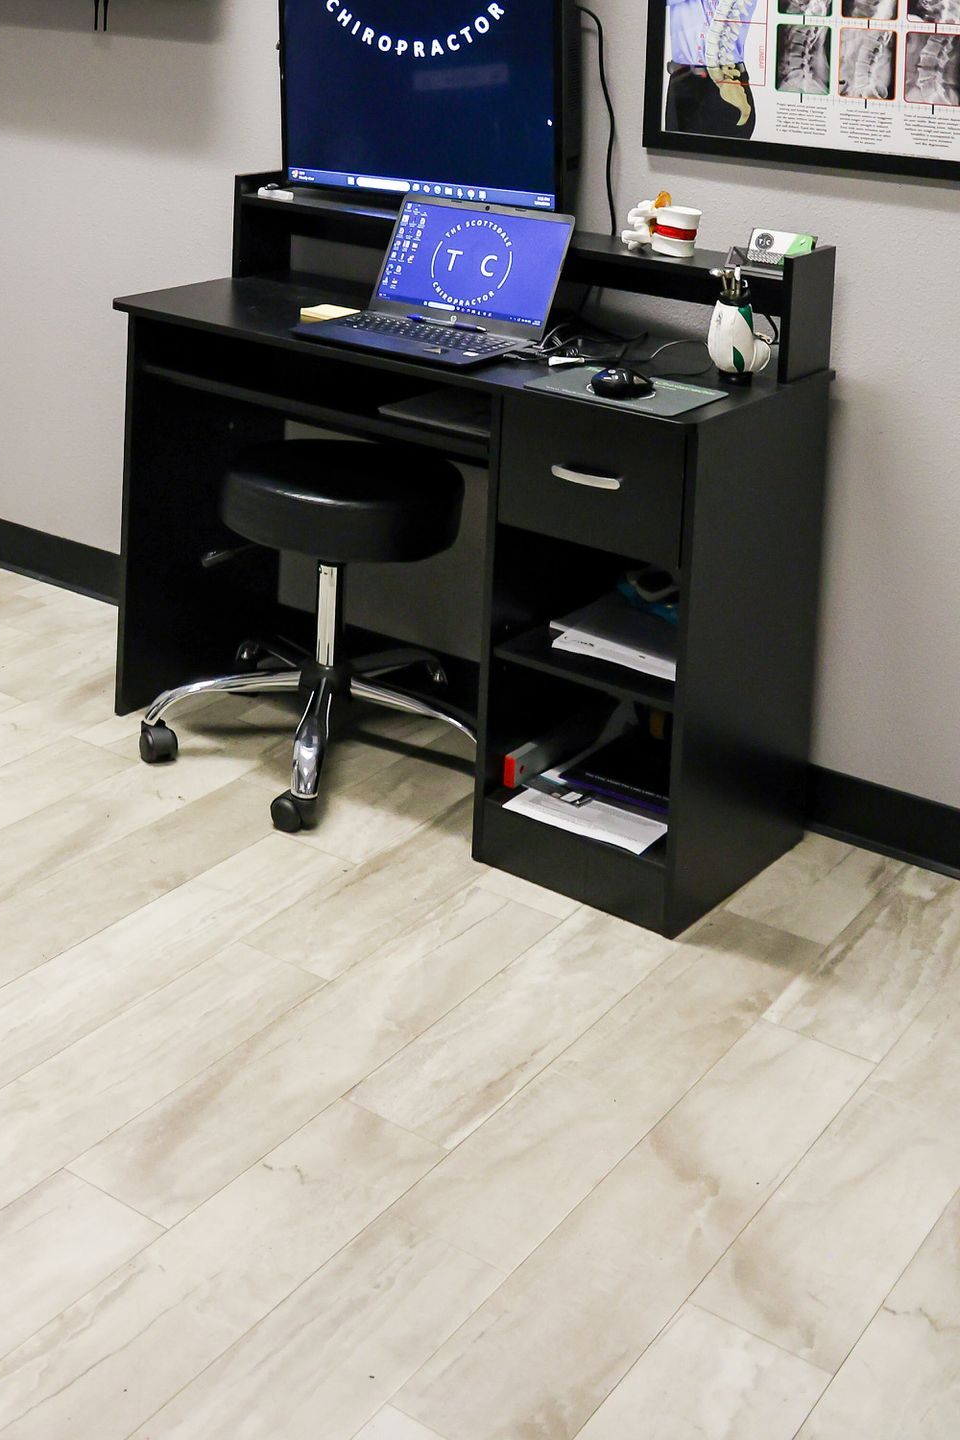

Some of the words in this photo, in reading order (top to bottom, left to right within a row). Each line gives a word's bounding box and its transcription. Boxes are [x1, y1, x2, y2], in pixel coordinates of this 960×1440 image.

[445, 224, 462, 239] THE
[465, 219, 513, 249] SCOTTSDALE
[431, 281, 496, 308] CHIROPRACTOR
